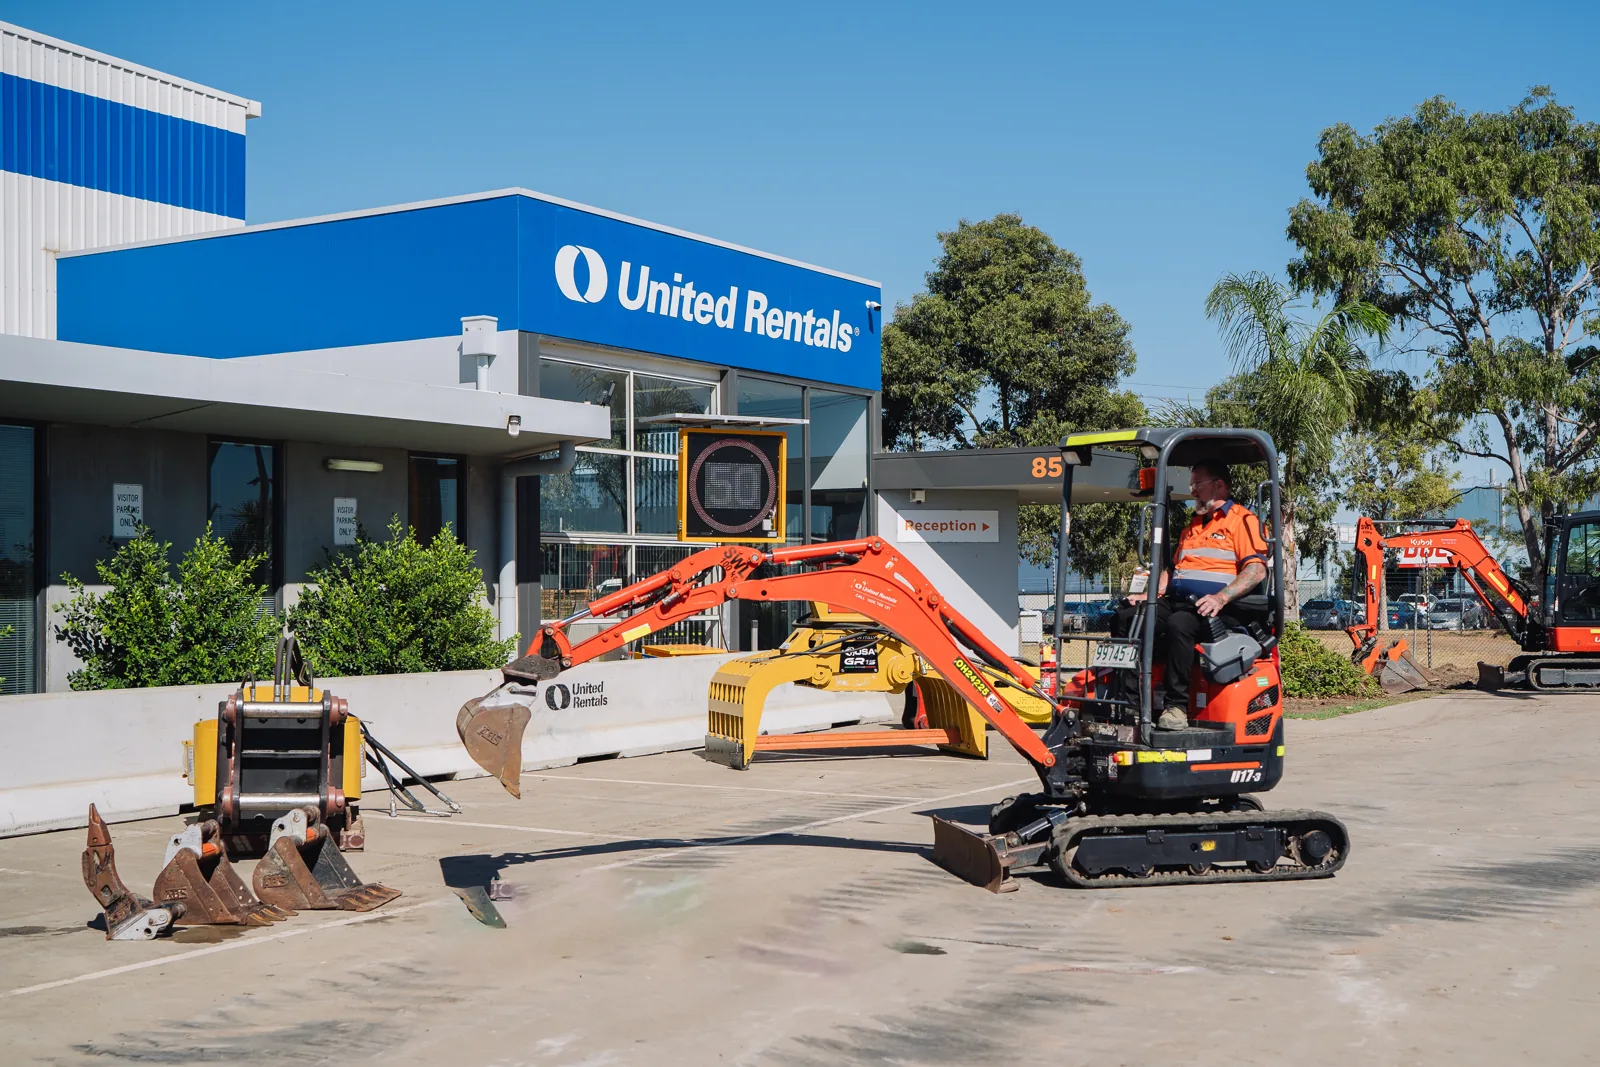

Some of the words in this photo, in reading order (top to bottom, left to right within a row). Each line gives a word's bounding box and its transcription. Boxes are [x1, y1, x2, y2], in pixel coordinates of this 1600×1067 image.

[617, 260, 738, 329] United
[744, 289, 853, 353] Rentals
[1031, 456, 1063, 479] 85
[117, 494, 139, 502] VISITOR
[116, 505, 140, 514] PARING
[336, 506, 354, 514] VISITOR
[338, 527, 352, 536] ONLY
[904, 519, 977, 533] Reception
[719, 557, 733, 571] 100
[723, 546, 744, 578] SWL
[861, 585, 880, 597] United
[955, 659, 990, 696] OH24225
[572, 681, 604, 695] United
[573, 694, 608, 709] Rentals
[1230, 769, 1261, 783] U17-3
